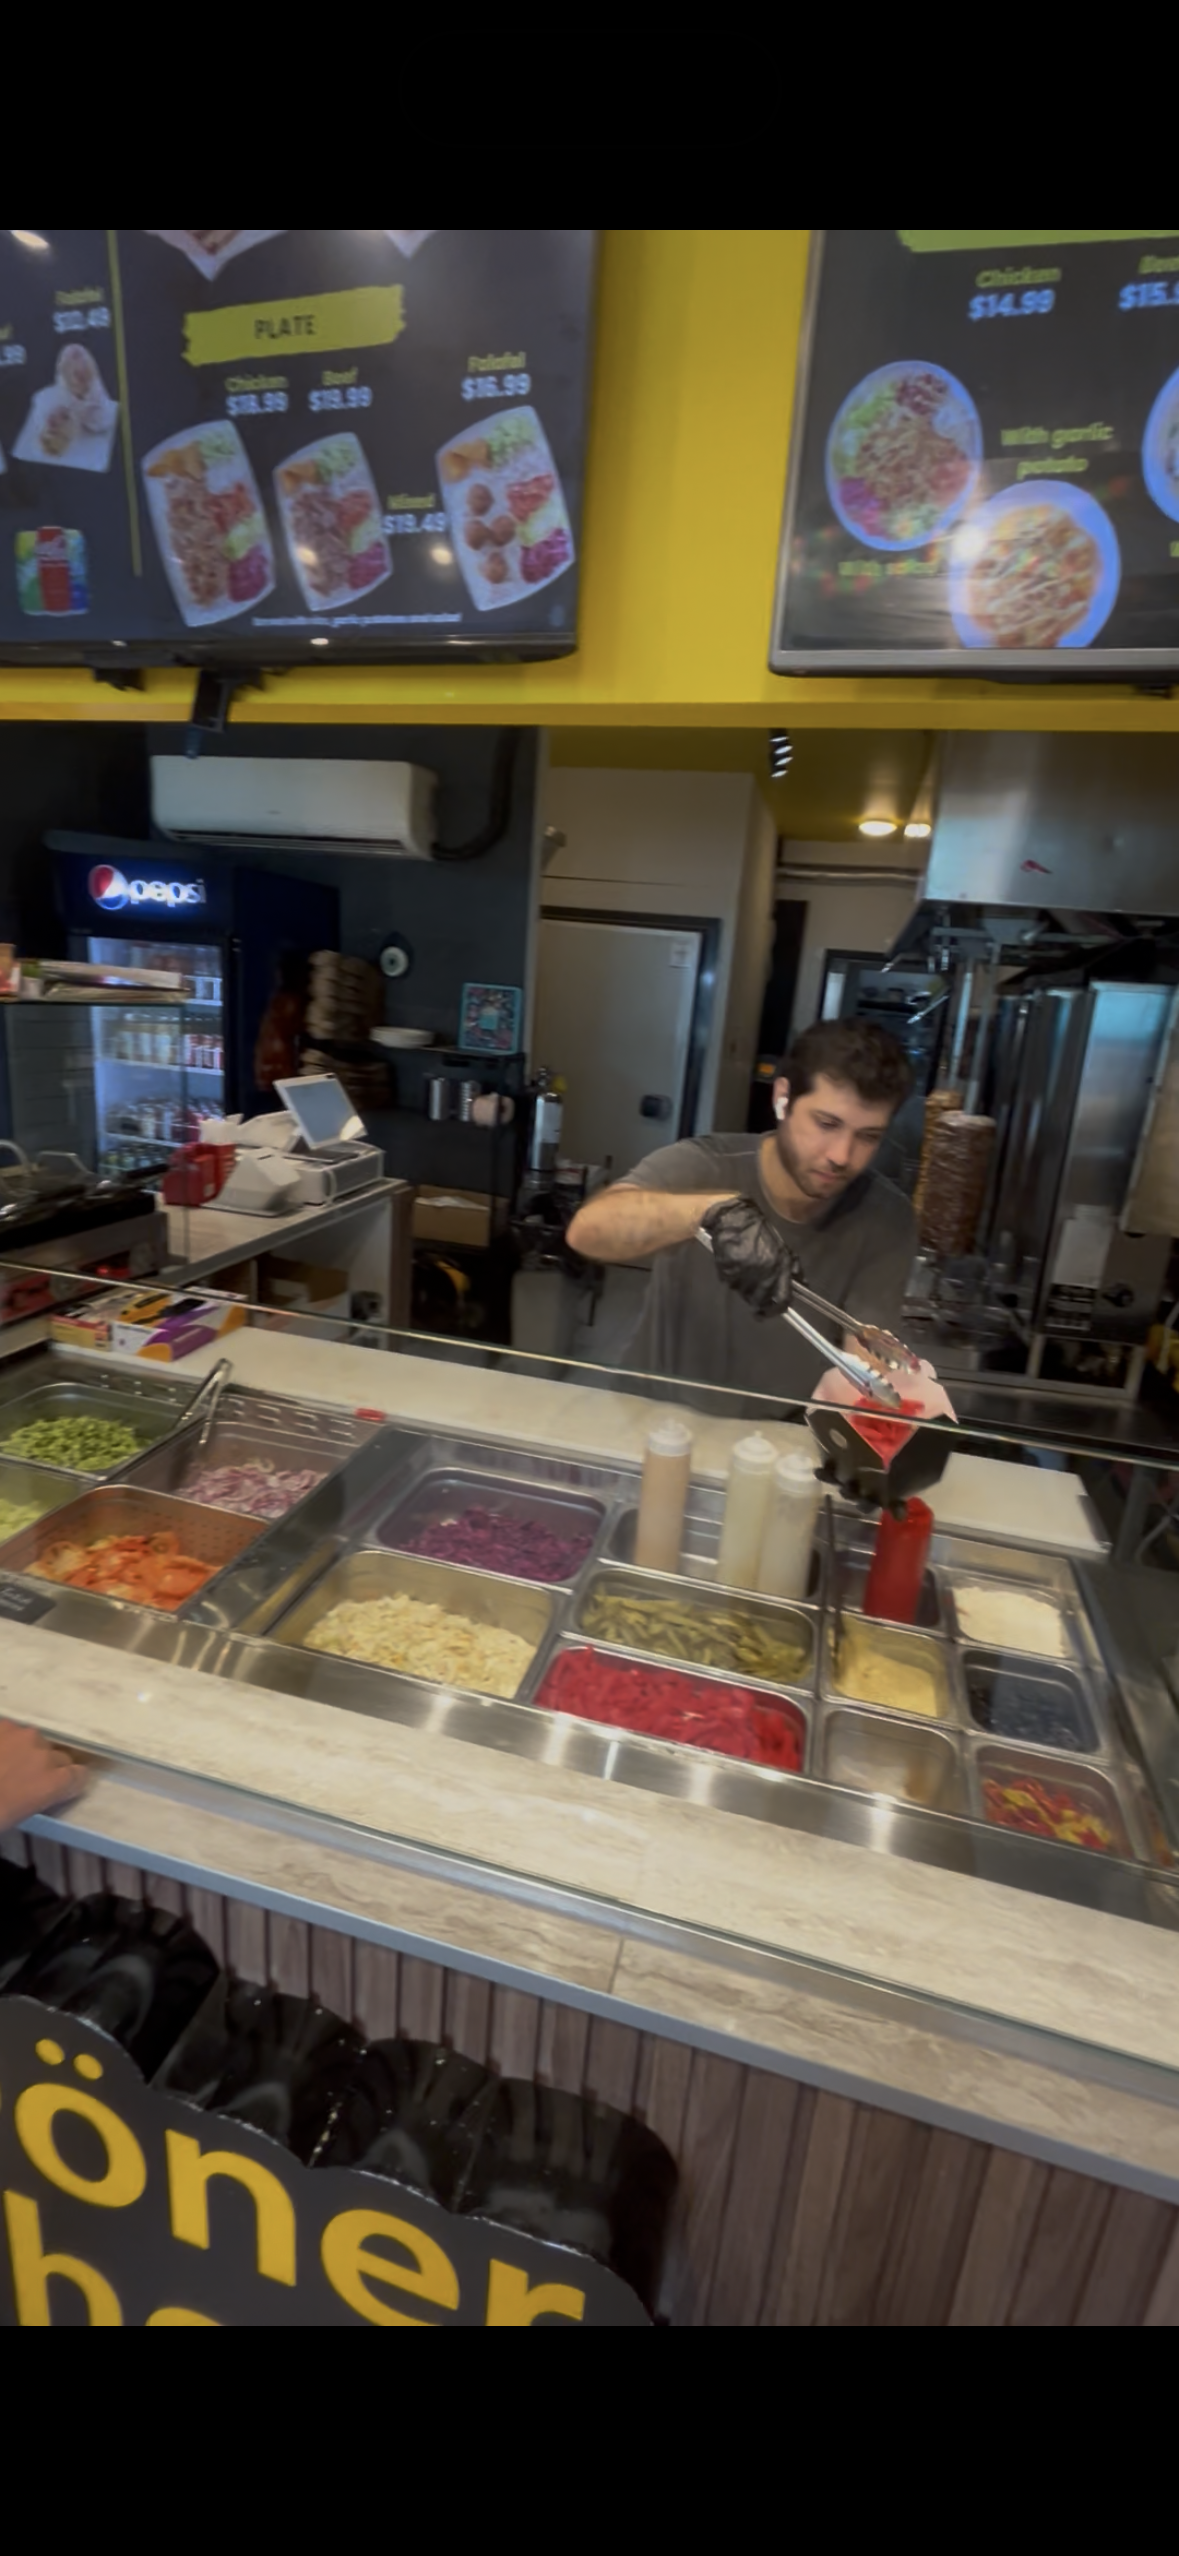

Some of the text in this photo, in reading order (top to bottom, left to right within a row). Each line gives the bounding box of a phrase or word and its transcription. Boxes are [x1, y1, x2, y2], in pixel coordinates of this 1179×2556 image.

[974, 266, 1062, 288] Chicken
[967, 289, 1056, 321] $14.99
[254, 314, 317, 340] PLATE
[308, 385, 374, 412] $19.99
[461, 373, 531, 401] $16.99
[1051, 421, 1114, 449] garlic
[130, 877, 206, 907] pepsi
[0, 2038, 586, 2327] öner
